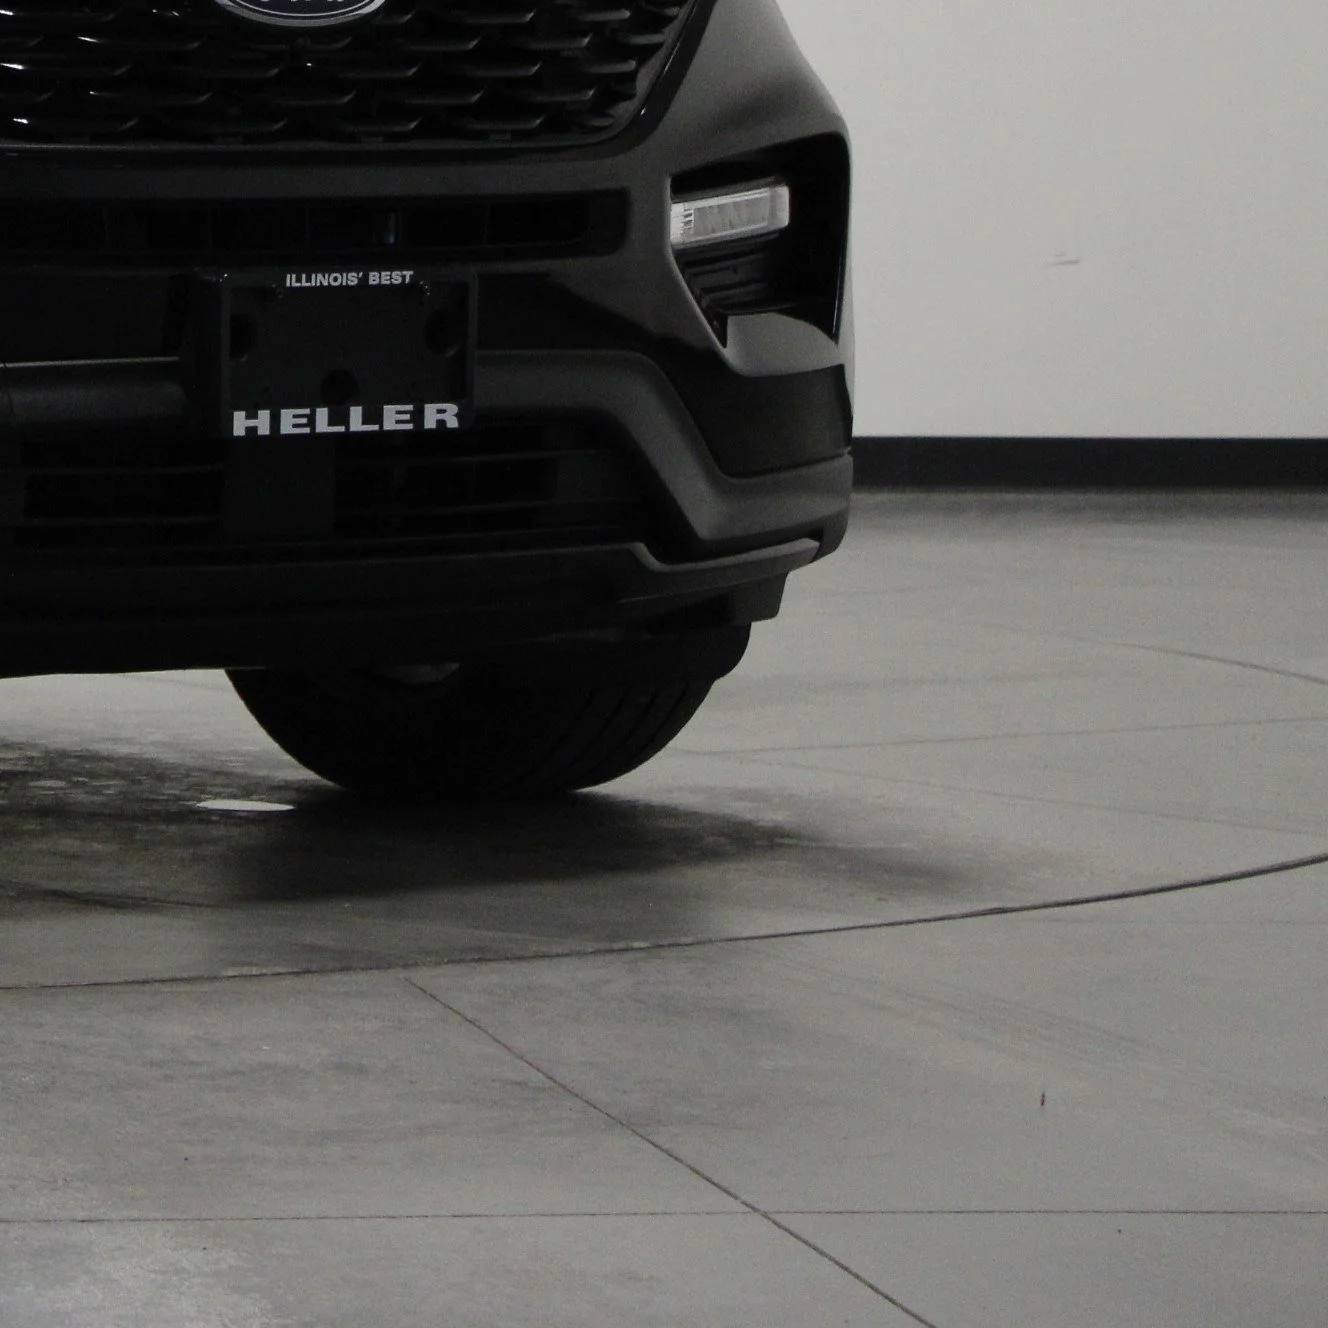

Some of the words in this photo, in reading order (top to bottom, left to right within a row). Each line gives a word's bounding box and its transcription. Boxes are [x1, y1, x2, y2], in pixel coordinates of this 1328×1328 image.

[286, 272, 363, 287] ILLINOIS'
[368, 270, 414, 285] BEST
[232, 403, 460, 437] HELLER
